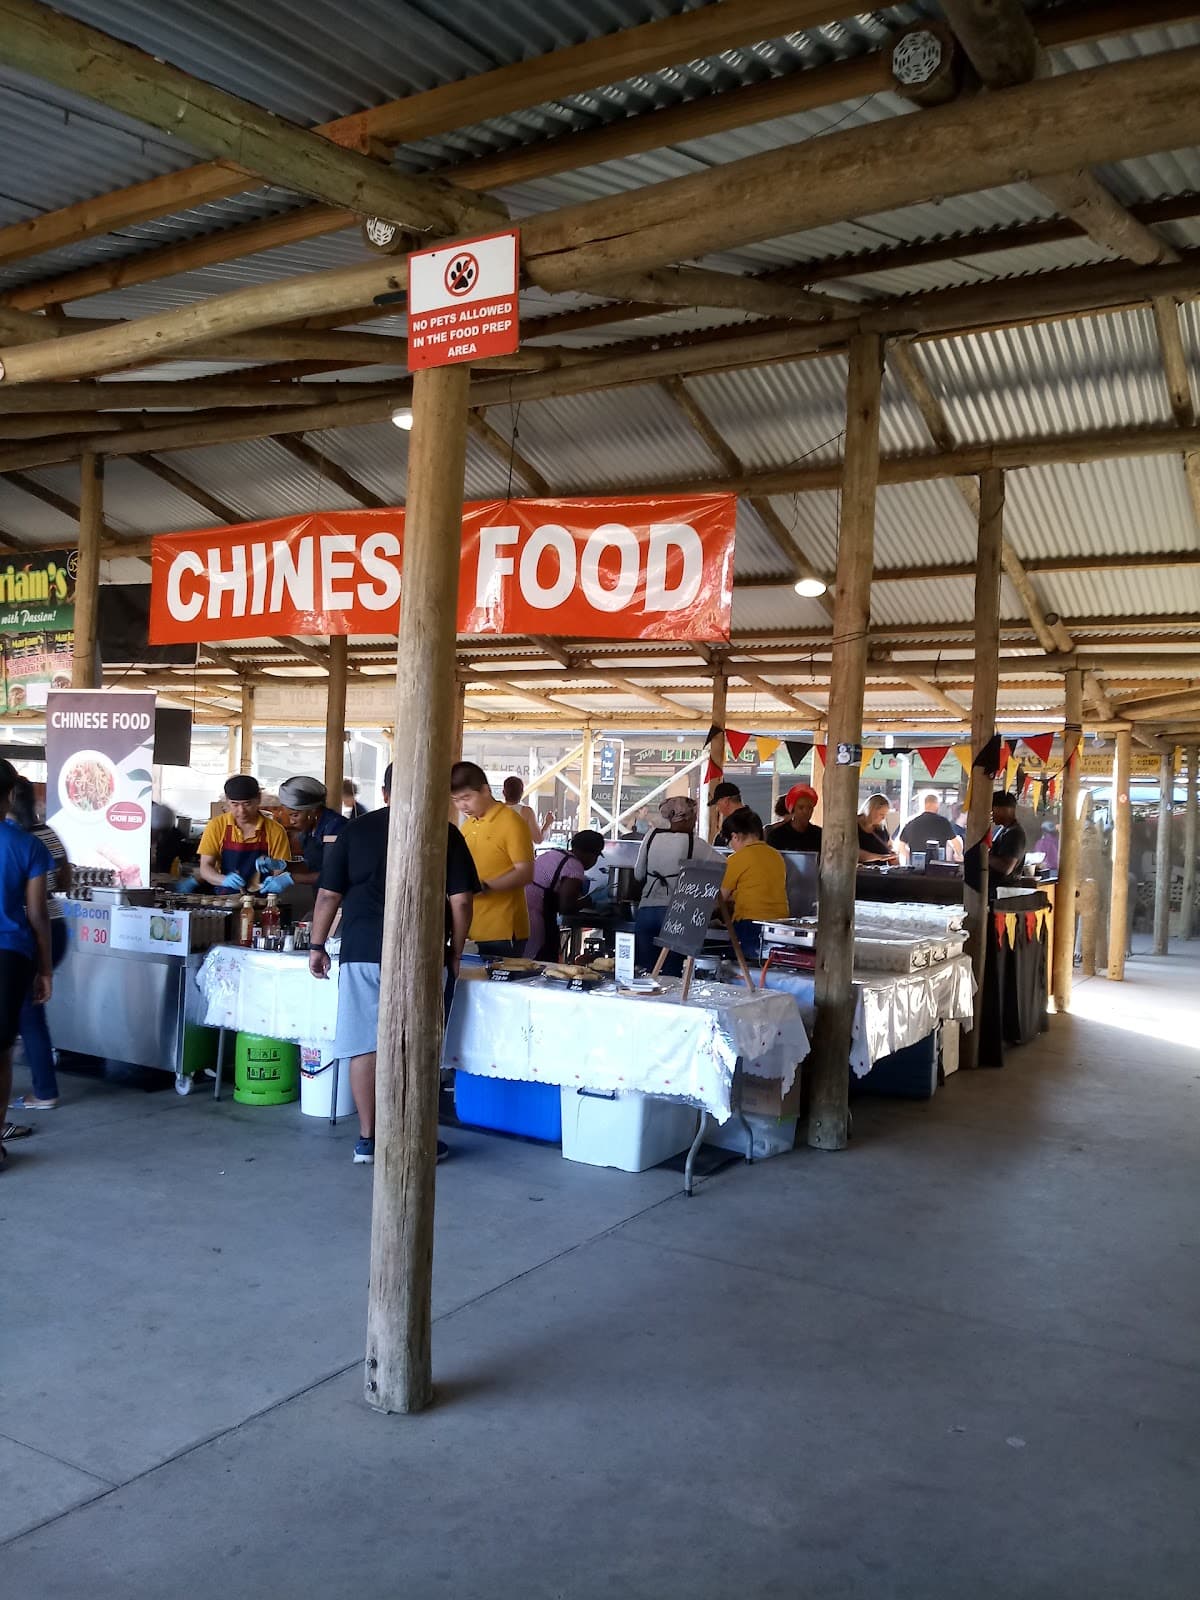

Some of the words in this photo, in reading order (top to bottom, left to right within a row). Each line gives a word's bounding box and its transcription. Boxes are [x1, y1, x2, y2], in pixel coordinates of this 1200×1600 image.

[413, 320, 427, 332] NO
[430, 313, 457, 328] PETS
[459, 303, 512, 321] ALLOWED
[413, 338, 424, 348] IN
[427, 332, 447, 345] THE
[450, 326, 479, 340] FOOD
[482, 320, 512, 335] PREP
[448, 343, 477, 357] AREA
[166, 532, 401, 623] CHINES
[475, 523, 703, 613] FOOD
[21, 609, 57, 627] Passion!
[51, 711, 108, 729] CHINESE
[113, 712, 150, 730] FOOD
[75, 903, 109, 920] Bacon
[93, 928, 107, 943] 30
